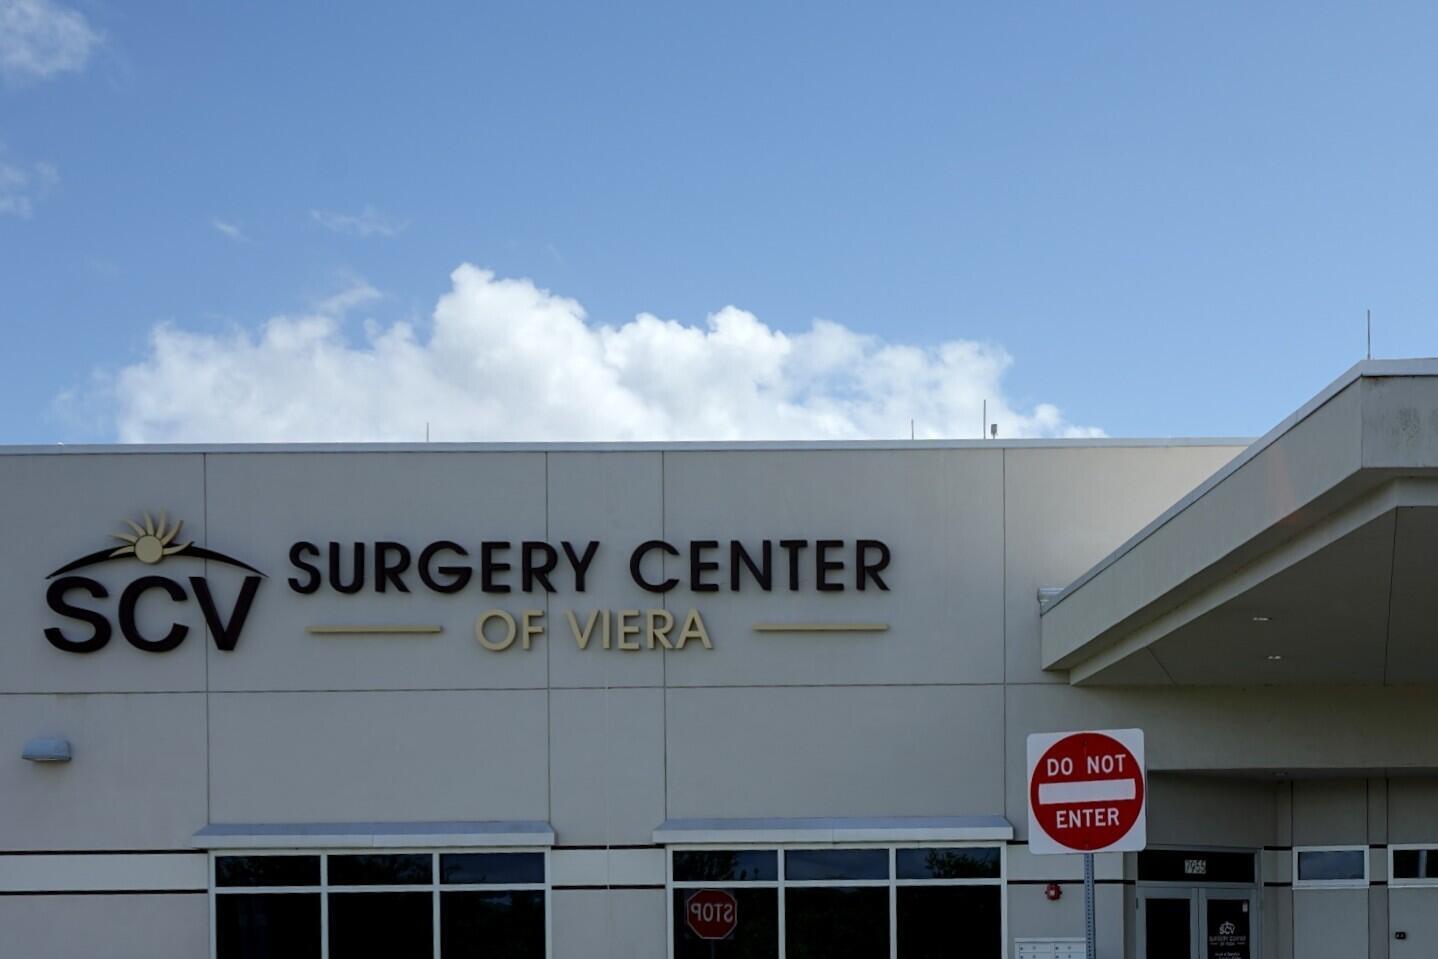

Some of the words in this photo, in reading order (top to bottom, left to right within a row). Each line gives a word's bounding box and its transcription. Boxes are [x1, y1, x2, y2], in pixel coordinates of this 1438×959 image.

[287, 540, 601, 595] SURGERY
[629, 538, 892, 592] CENTER
[43, 575, 264, 653] SCV
[475, 609, 545, 651] OF
[565, 608, 713, 651] VIERA
[1046, 757, 1073, 777] DO
[1087, 754, 1127, 774] NOT
[1055, 808, 1120, 829] ENTER
